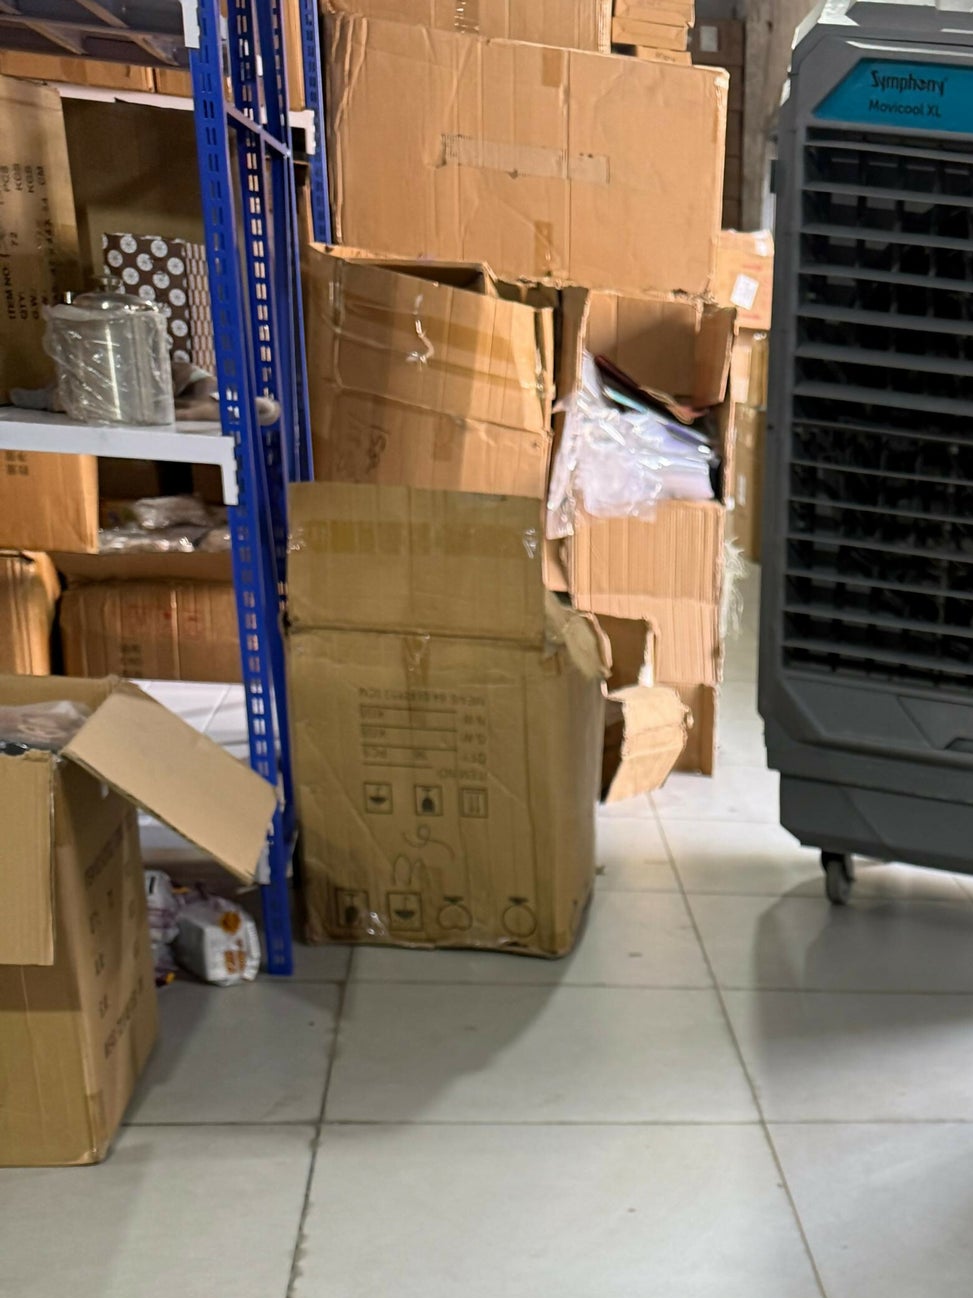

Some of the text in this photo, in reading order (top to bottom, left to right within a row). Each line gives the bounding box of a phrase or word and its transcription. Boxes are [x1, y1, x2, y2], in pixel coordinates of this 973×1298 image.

[871, 70, 944, 96] Symphony
[868, 99, 941, 118] Movicool XL
